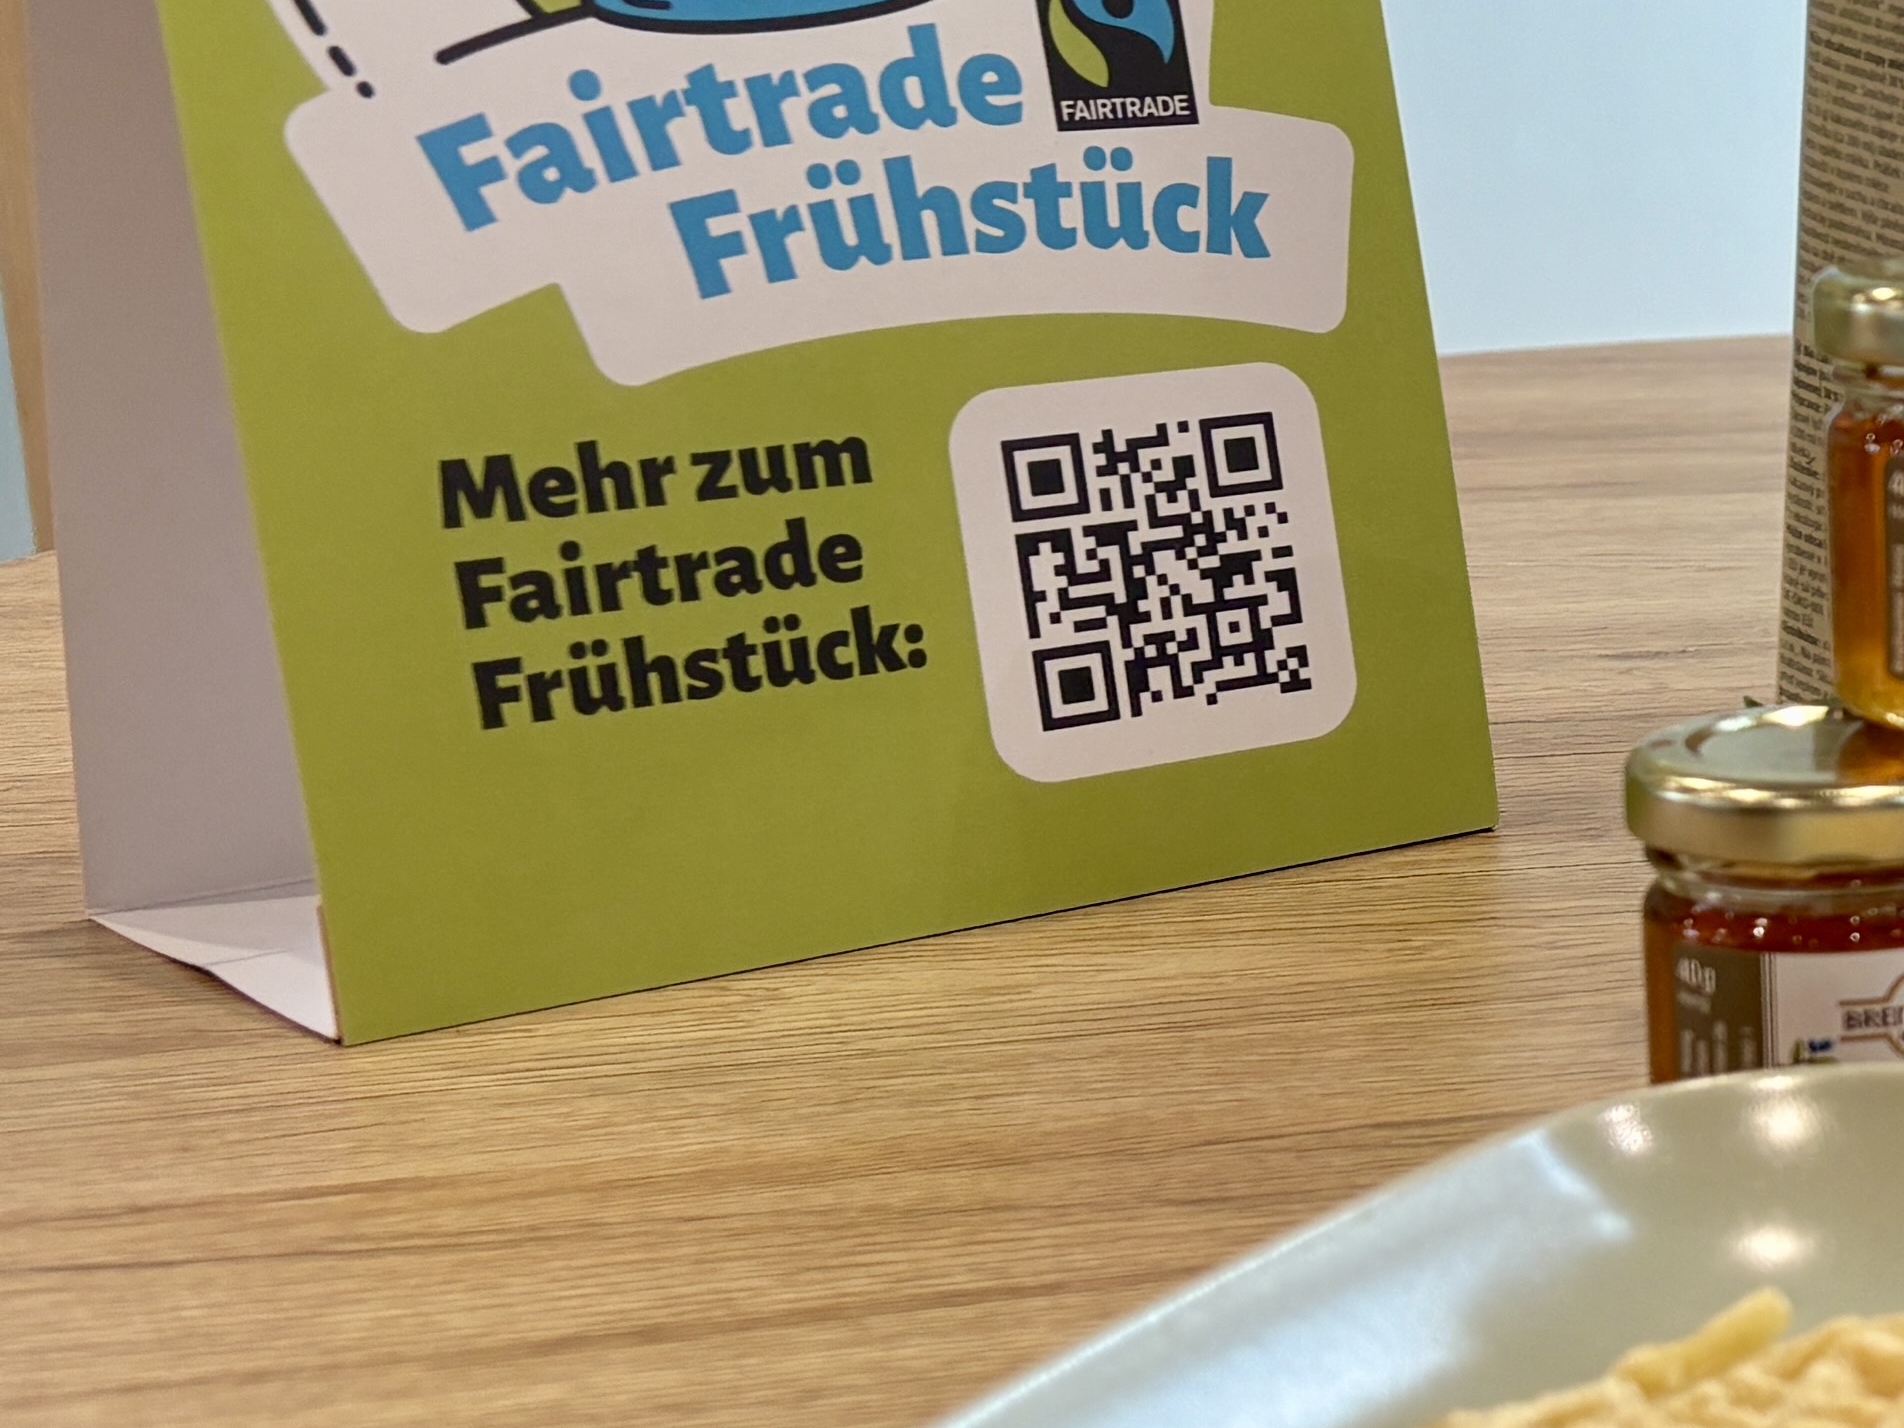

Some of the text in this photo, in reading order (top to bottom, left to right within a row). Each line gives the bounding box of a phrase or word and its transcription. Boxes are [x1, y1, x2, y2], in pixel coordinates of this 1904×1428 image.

[415, 22, 1024, 232] Fairtrade
[1059, 93, 1190, 124] FAIRTRADE
[666, 146, 1272, 301] Frühstück
[439, 436, 872, 528] Mehr zum
[454, 518, 864, 629] Fairtrade
[472, 606, 928, 730] Frühstück:
